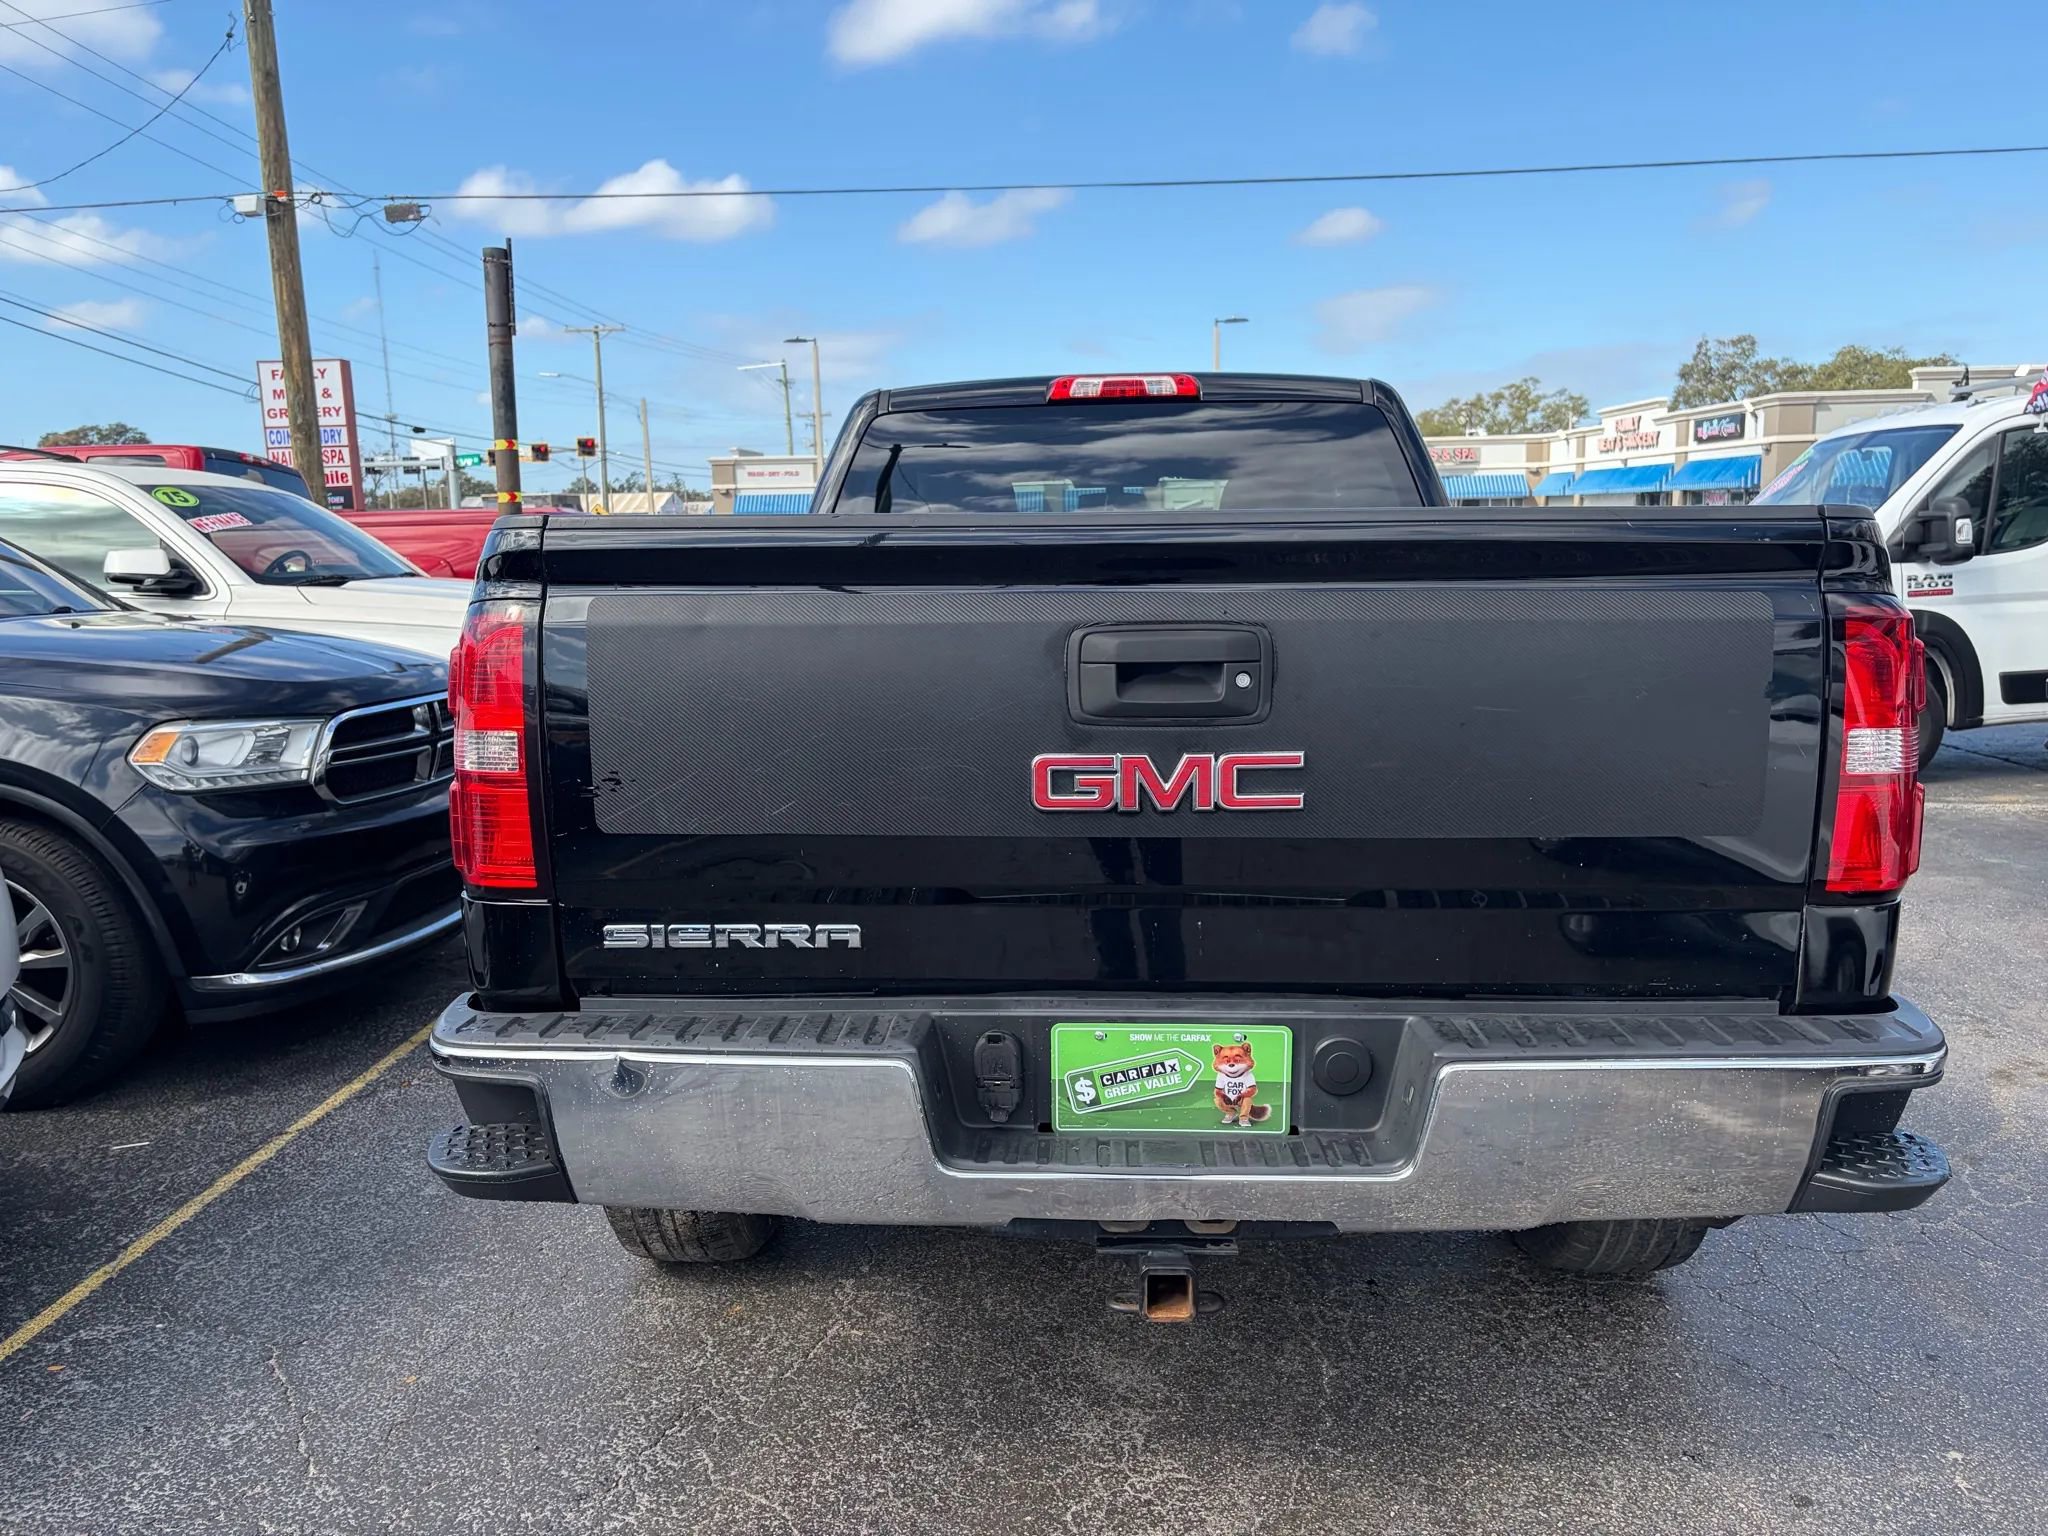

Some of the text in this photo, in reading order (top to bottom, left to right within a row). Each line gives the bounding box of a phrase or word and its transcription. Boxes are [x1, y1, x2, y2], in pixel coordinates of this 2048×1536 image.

[321, 388, 332, 399] &
[1454, 447, 1477, 460] SPA
[1907, 573, 1953, 581] RAM
[1907, 580, 1953, 588] 1500
[1031, 752, 1304, 811] GMC
[603, 924, 862, 949] SIERRA
[1129, 1033, 1212, 1042] SHOW ME THE CARFAX
[1101, 1060, 1179, 1086] CARFAX
[1104, 1073, 1182, 1099] GREAT VALUE
[1226, 1081, 1244, 1089] CAR
